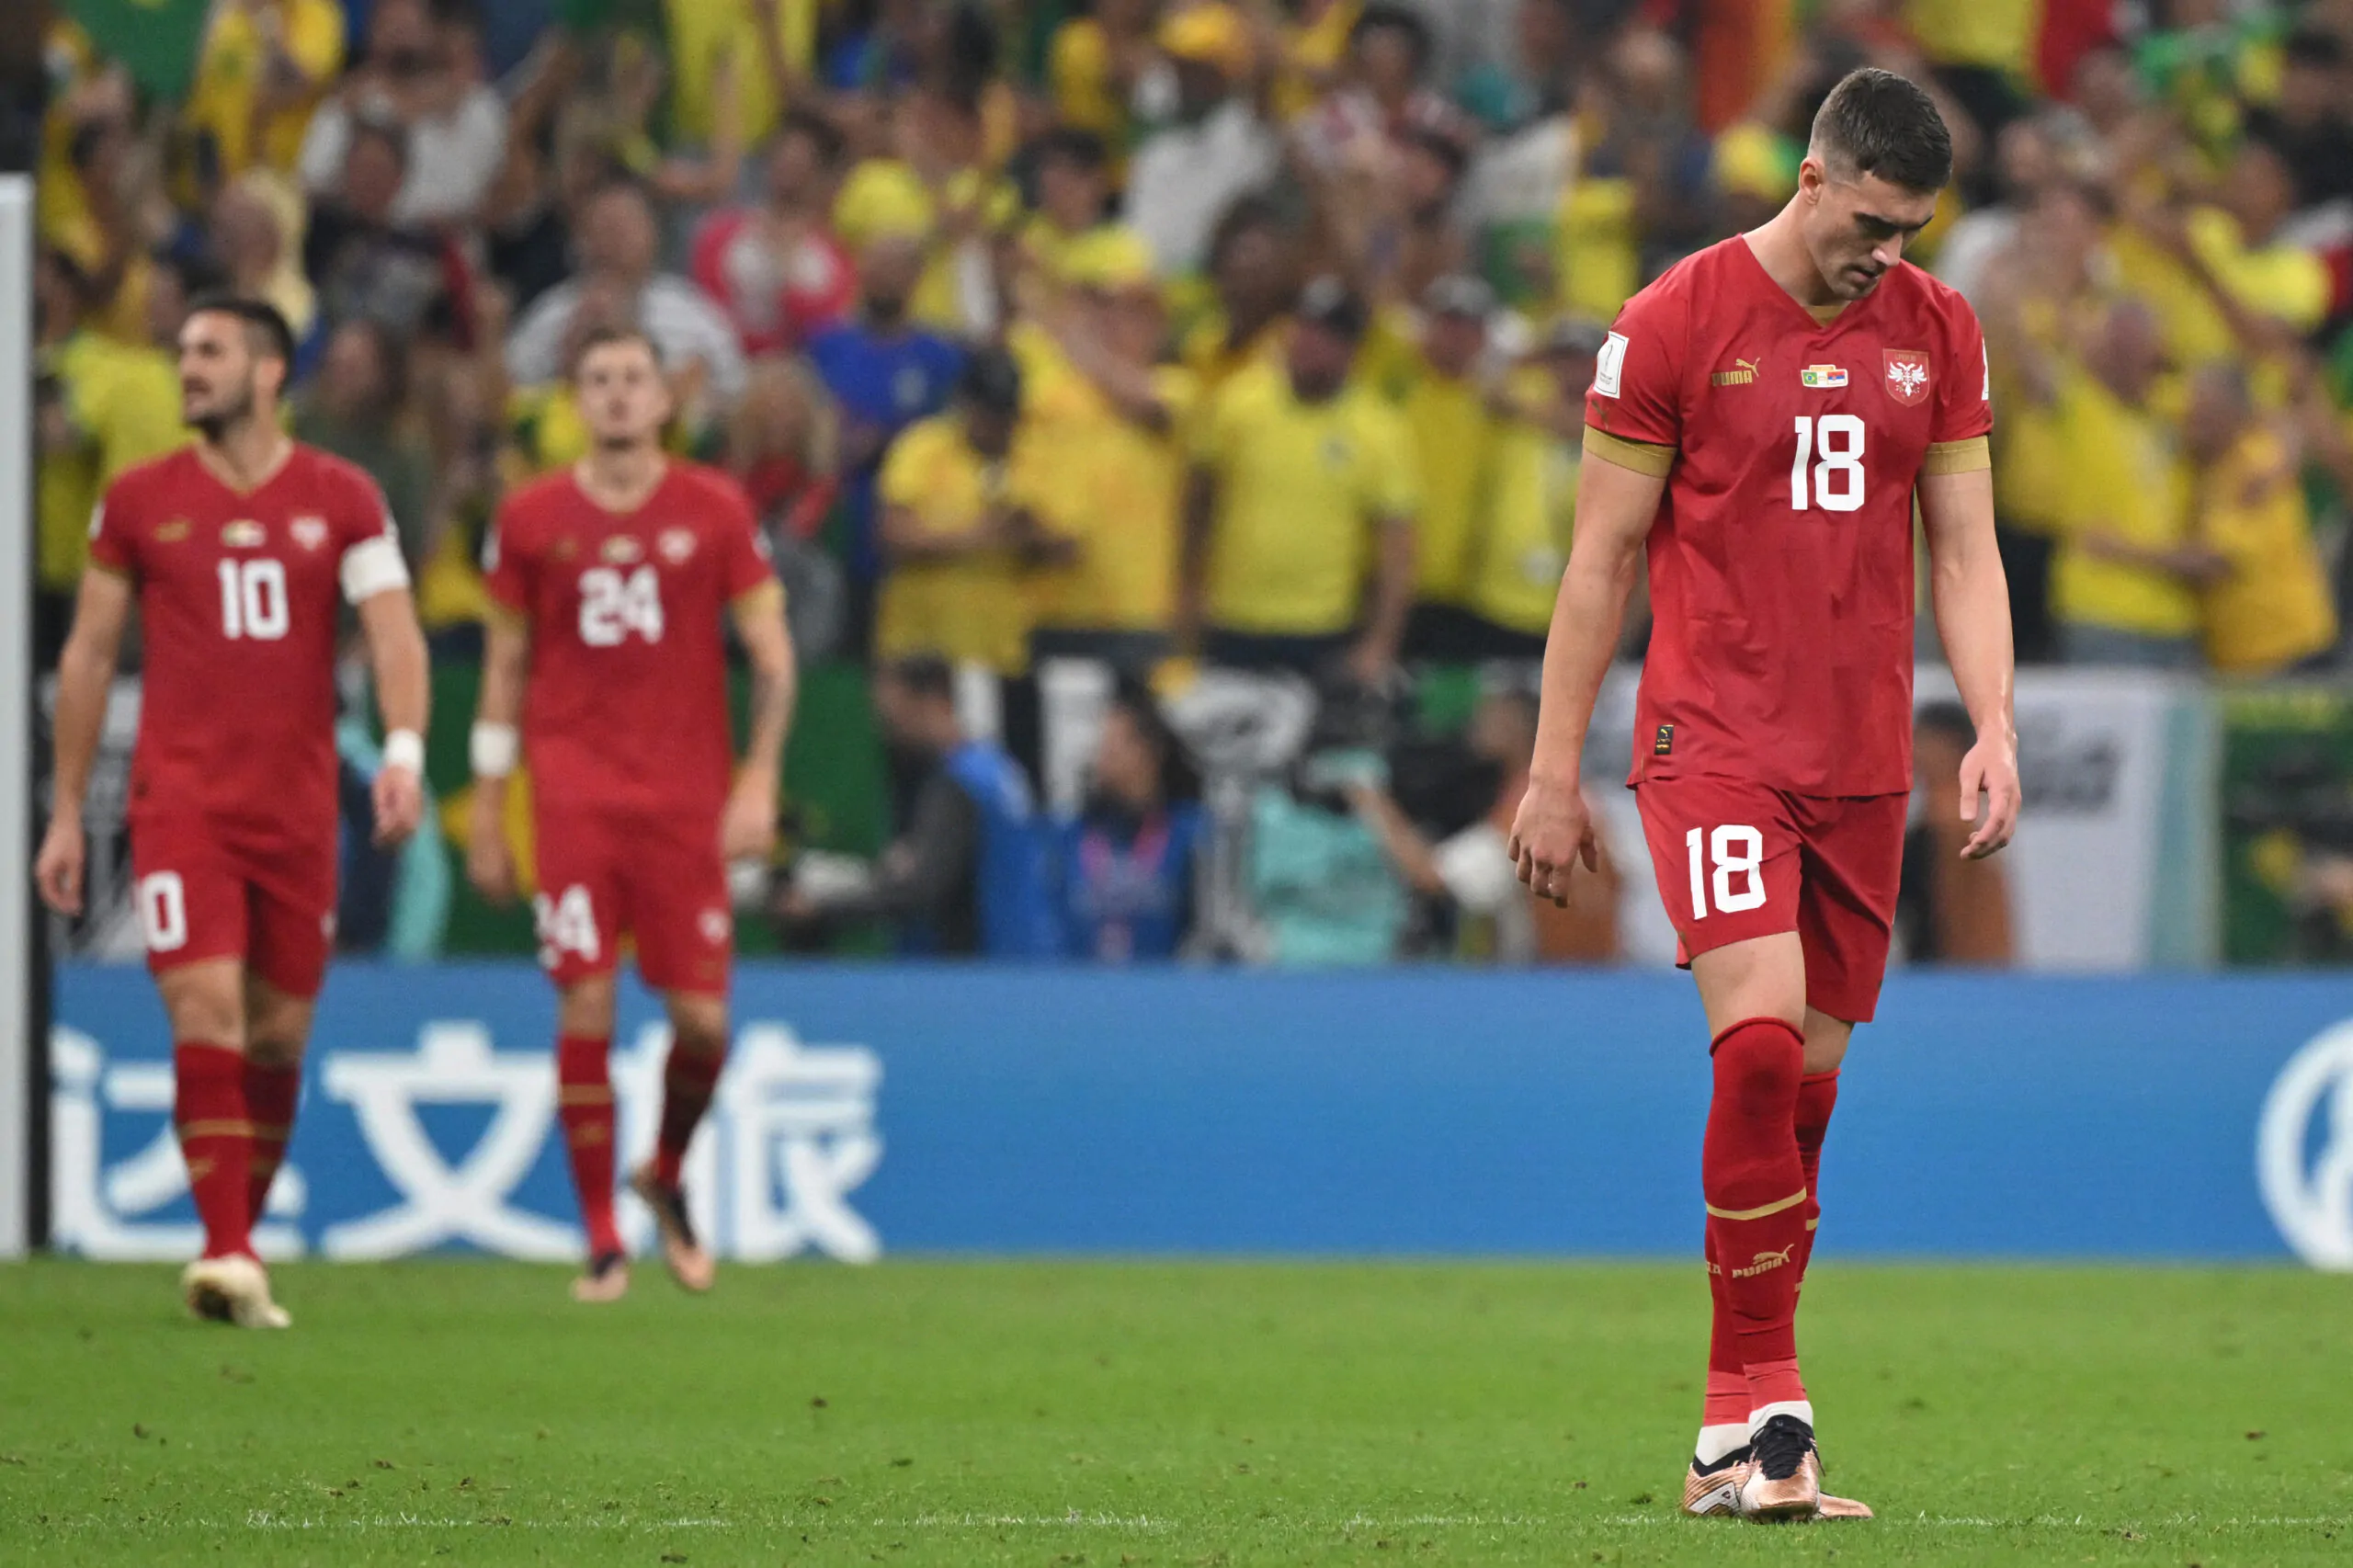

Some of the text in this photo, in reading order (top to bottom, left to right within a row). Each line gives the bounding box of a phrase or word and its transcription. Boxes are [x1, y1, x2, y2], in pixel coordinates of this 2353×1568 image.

[1711, 369, 1754, 387] PUMA
[1790, 414, 1865, 512] 18
[218, 557, 290, 641] 10
[578, 563, 664, 648] 24
[1686, 824, 1767, 920] 18
[1732, 1257, 1784, 1278] PUMA
